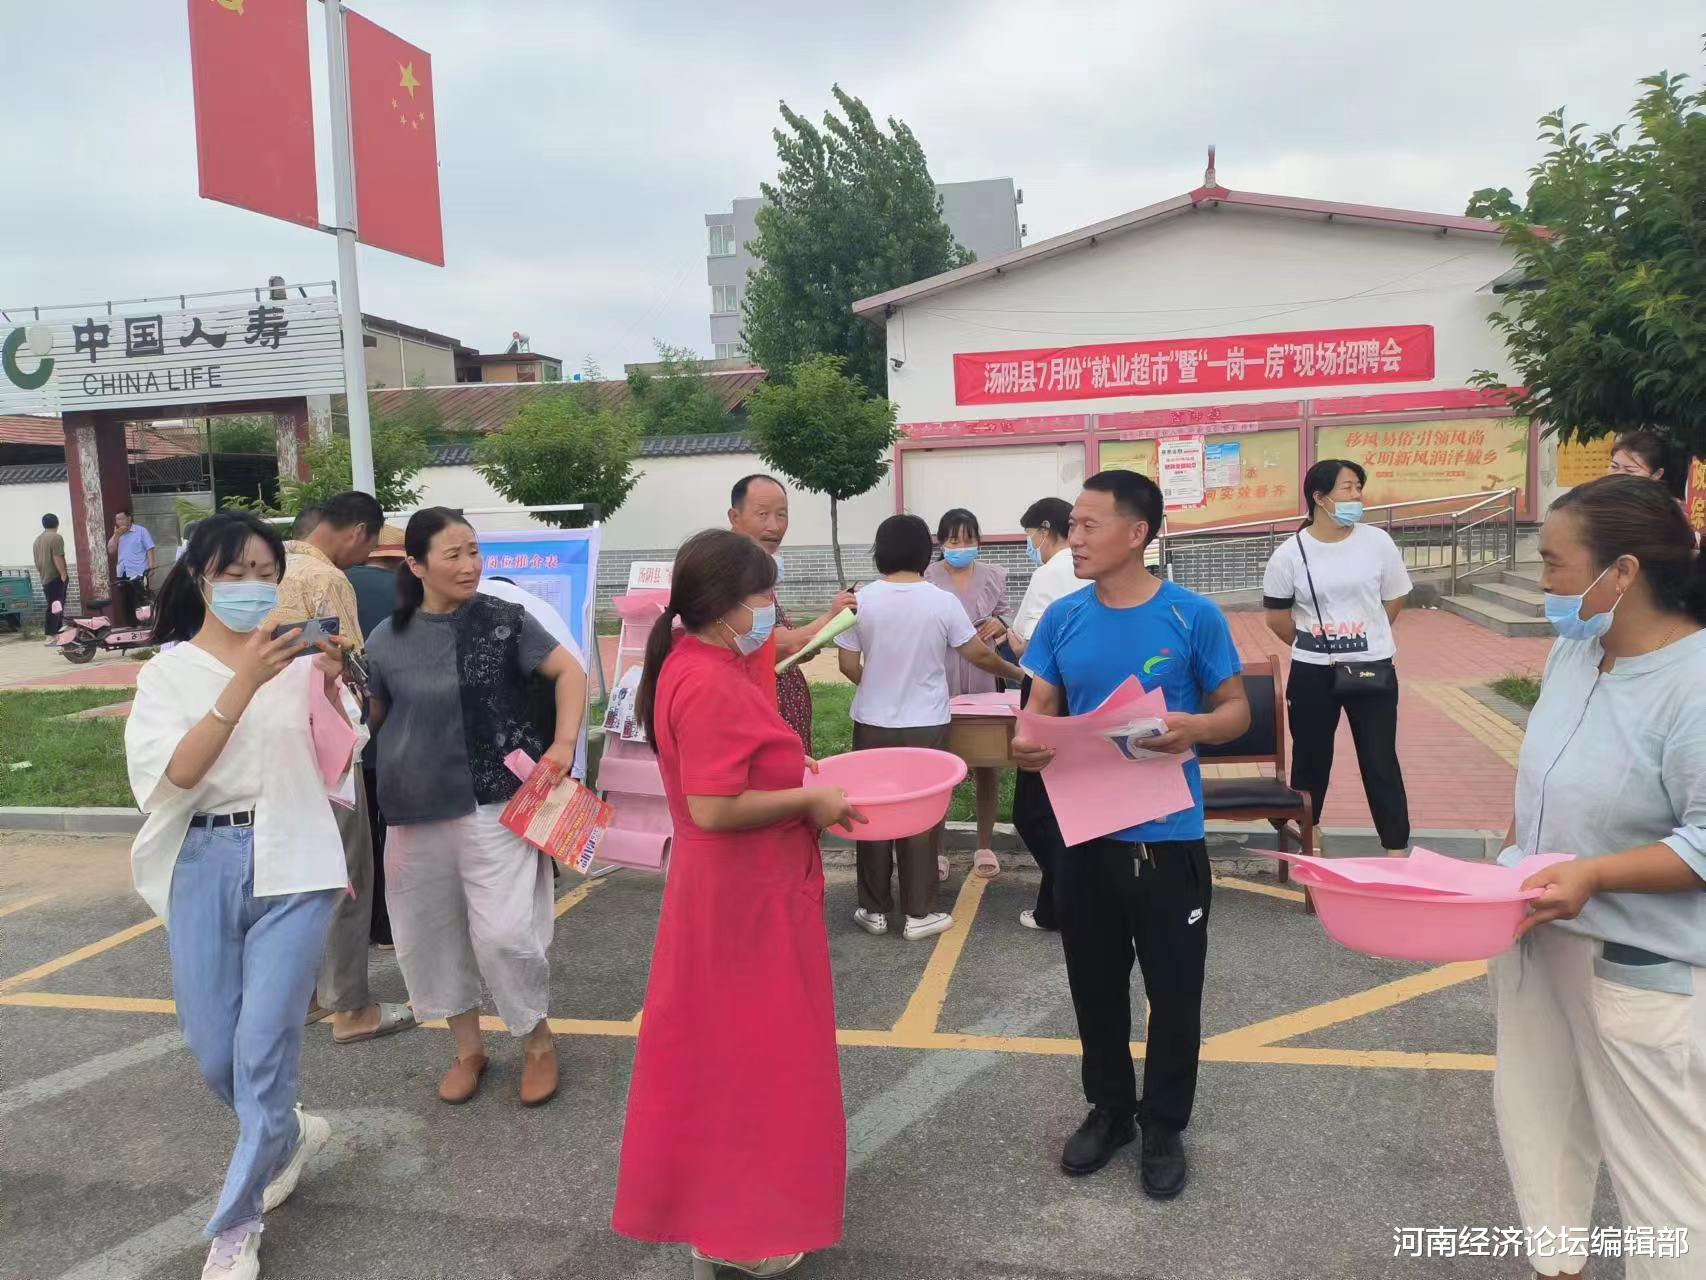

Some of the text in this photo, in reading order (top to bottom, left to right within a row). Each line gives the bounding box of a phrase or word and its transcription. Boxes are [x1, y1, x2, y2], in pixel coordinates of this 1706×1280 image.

[72, 304, 289, 364] 中国人寿
[83, 365, 222, 396] CHINA LIFE
[1345, 430, 1485, 448] 移风易俗引领风尚
[1362, 449, 1498, 467] 文明新风润泽城乡
